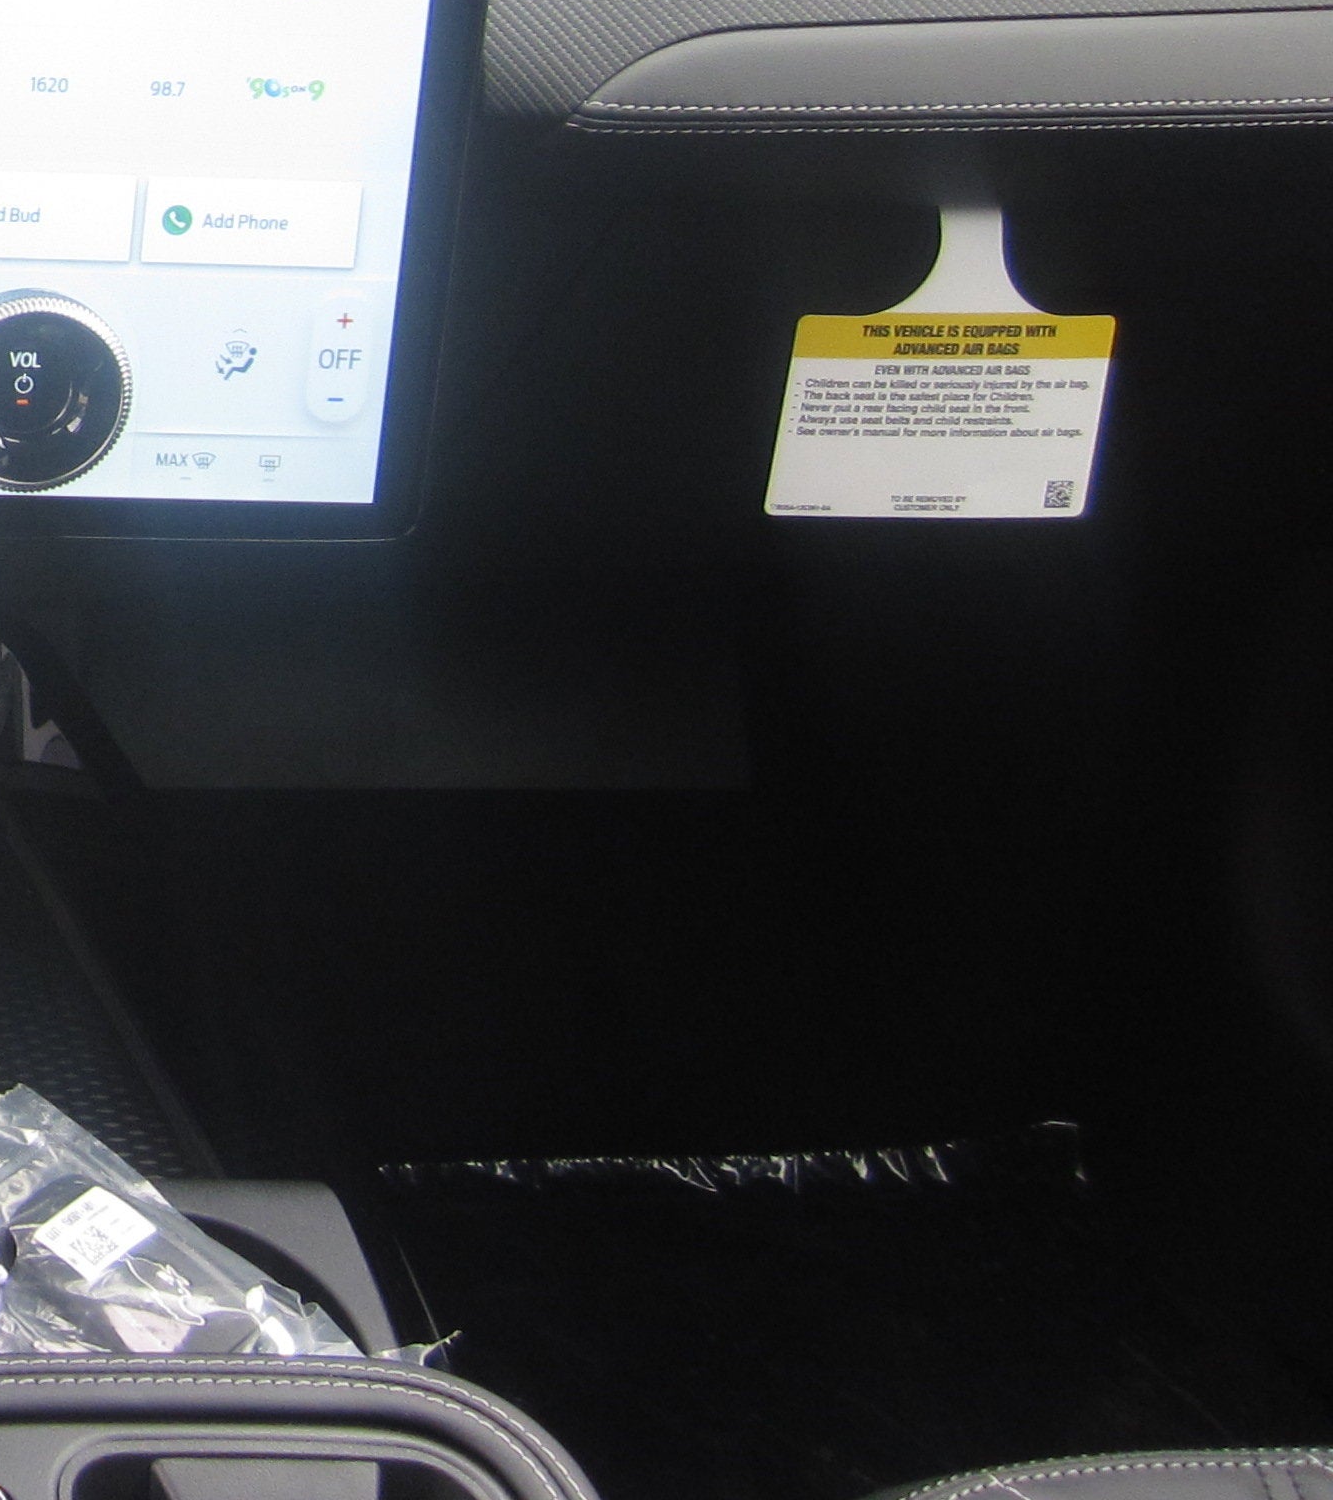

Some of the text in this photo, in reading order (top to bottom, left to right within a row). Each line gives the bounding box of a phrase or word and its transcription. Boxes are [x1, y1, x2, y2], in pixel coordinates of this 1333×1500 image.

[30, 76, 69, 94] 1620
[150, 81, 186, 97] 98.7
[9, 207, 41, 223] Bud
[202, 212, 289, 231] Add Phone
[862, 324, 1058, 338] THIS VEHICLE IS EQUIPPED WITH
[893, 342, 1020, 356] ADVANCED AIR BAGS
[9, 351, 42, 369] VOL
[318, 348, 362, 370] OFF
[874, 364, 1031, 376] EVEN WITH ADVANCED AIR BAGS
[805, 378, 850, 389] Children
[852, 380, 871, 389] can
[873, 379, 887, 389] be
[889, 378, 917, 389] killed
[919, 380, 932, 389] or
[933, 379, 981, 391] seriously
[983, 379, 1019, 391] injured
[1021, 379, 1033, 391] by
[1035, 379, 1052, 389] the
[804, 390, 823, 400] The
[825, 390, 850, 400] back
[852, 391, 875, 400] seat
[889, 391, 906, 400] the
[941, 391, 970, 403] place
[972, 392, 988, 401] for
[800, 402, 831, 412] Never
[886, 403, 918, 415] facing
[920, 403, 946, 413] child
[949, 404, 970, 413] seat
[984, 404, 1001, 413] the
[798, 414, 837, 426] Always
[861, 415, 883, 425] seat
[885, 415, 910, 425] belts
[912, 415, 933, 425] and
[935, 415, 961, 425] child
[796, 426, 816, 436] See
[862, 427, 901, 437] manual
[903, 427, 918, 437] for
[919, 429, 947, 437] more
[949, 427, 1008, 437] information
[1009, 428, 1039, 437] about
[155, 452, 188, 467] MAX
